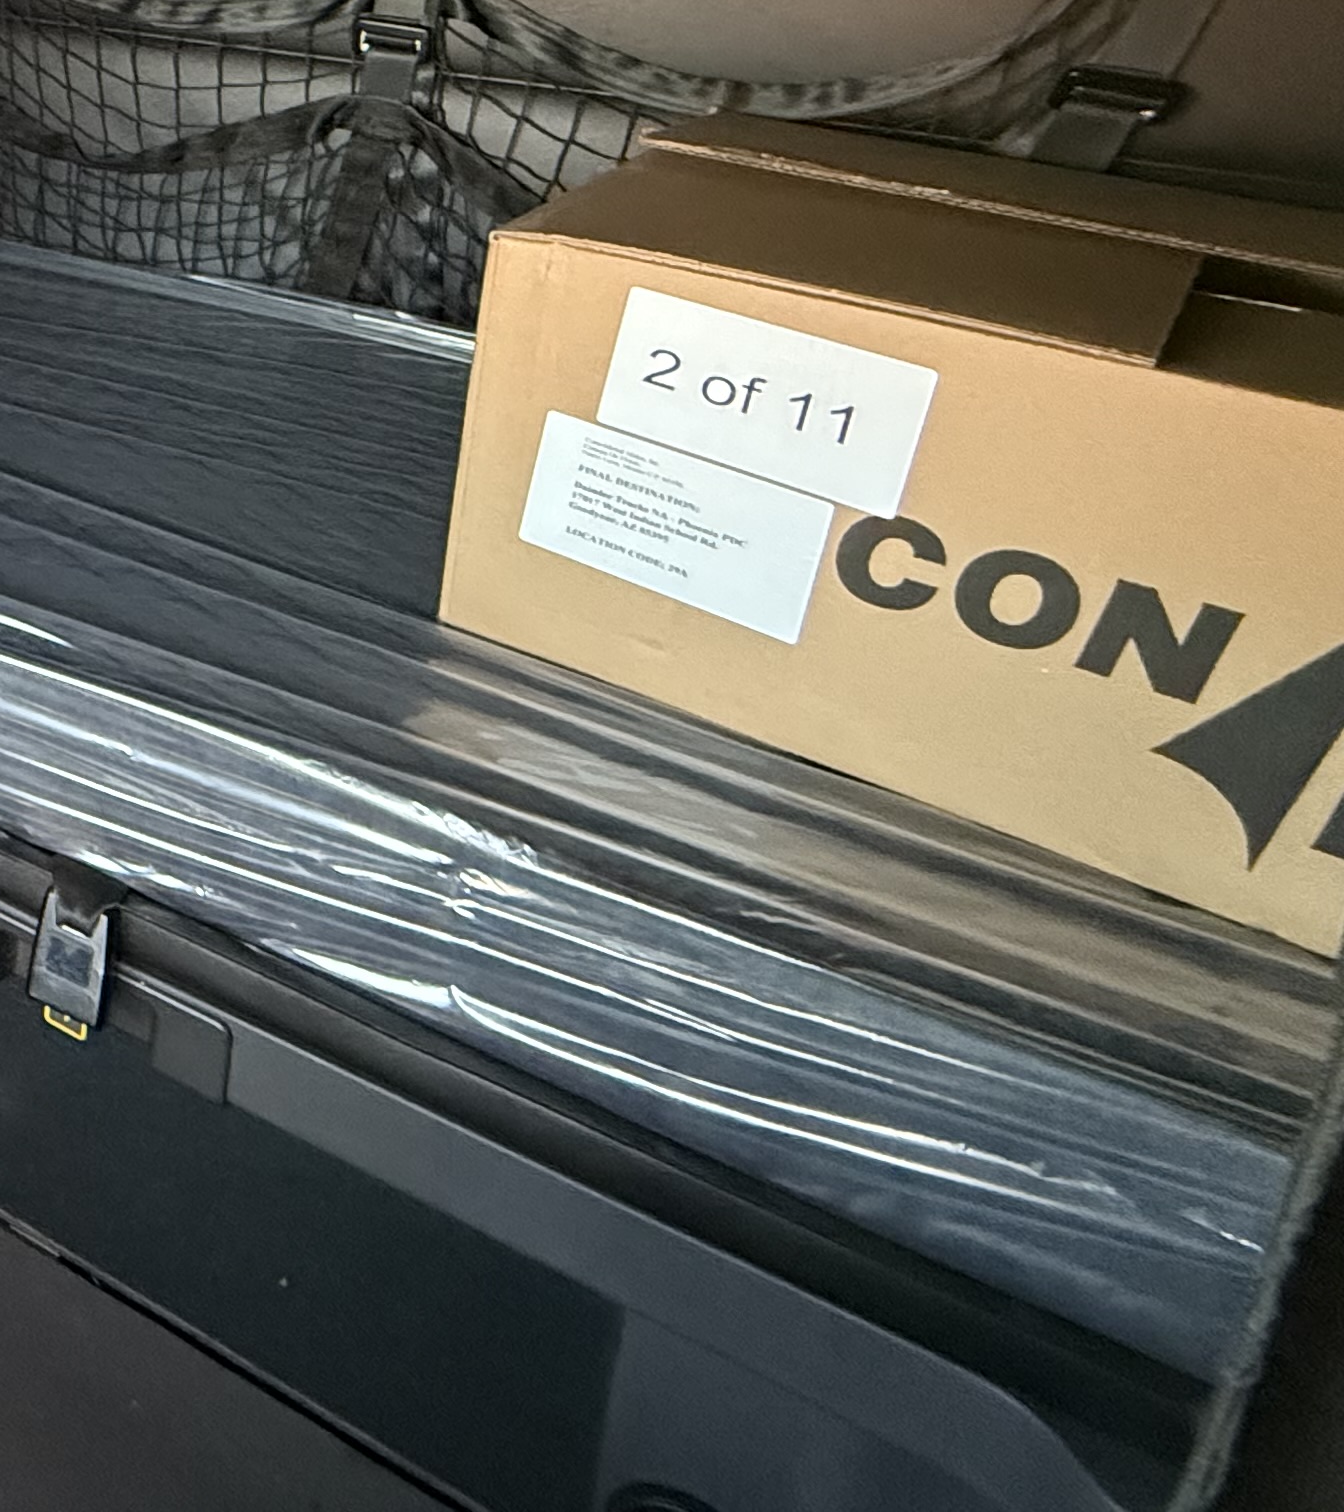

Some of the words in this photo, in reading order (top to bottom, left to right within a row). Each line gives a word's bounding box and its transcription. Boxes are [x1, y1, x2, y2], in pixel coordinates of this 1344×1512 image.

[642, 349, 681, 391] 2
[701, 376, 768, 414] of
[789, 393, 855, 445] 11
[578, 464, 613, 482] FINAL
[835, 514, 1247, 705] CON
